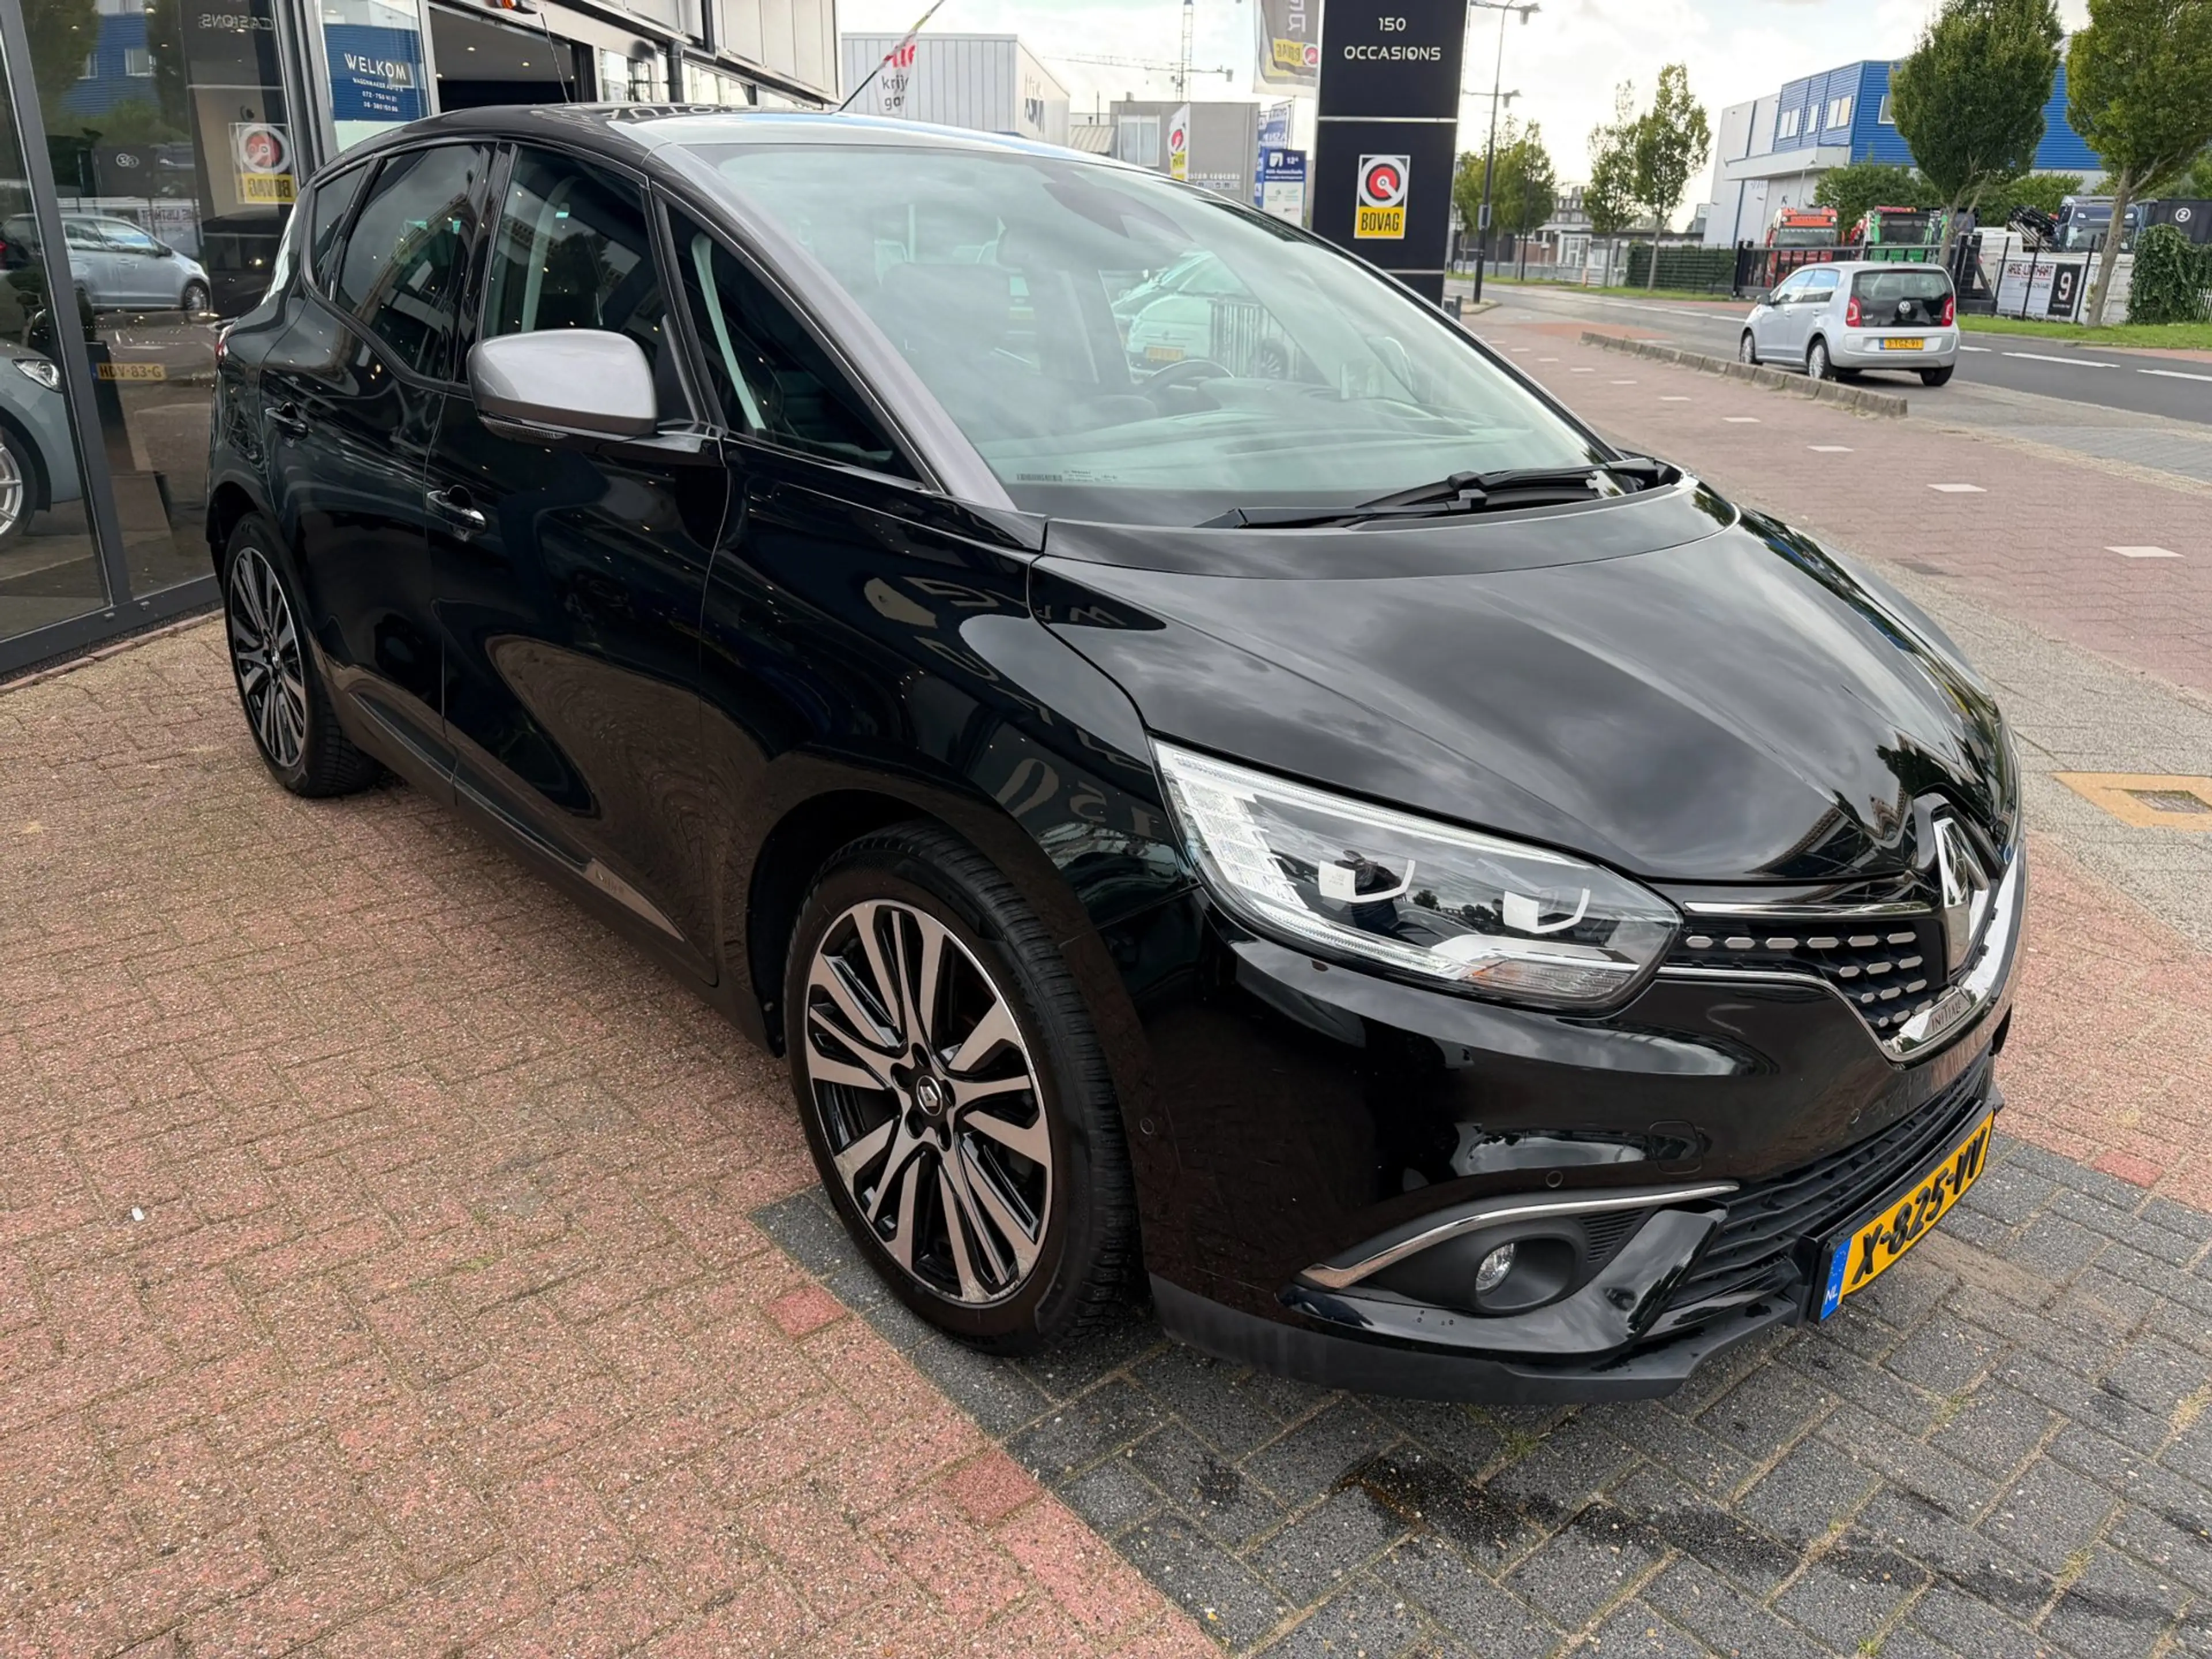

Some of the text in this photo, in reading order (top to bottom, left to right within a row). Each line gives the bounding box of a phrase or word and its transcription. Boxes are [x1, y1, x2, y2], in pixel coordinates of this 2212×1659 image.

[1378, 17, 1407, 32] 150
[1343, 45, 1442, 61] OCCASIONS
[344, 52, 407, 81] WELKOM
[1361, 211, 1400, 232] BOVAG
[2057, 271, 2073, 301] 9
[1824, 1283, 1839, 1304] NL
